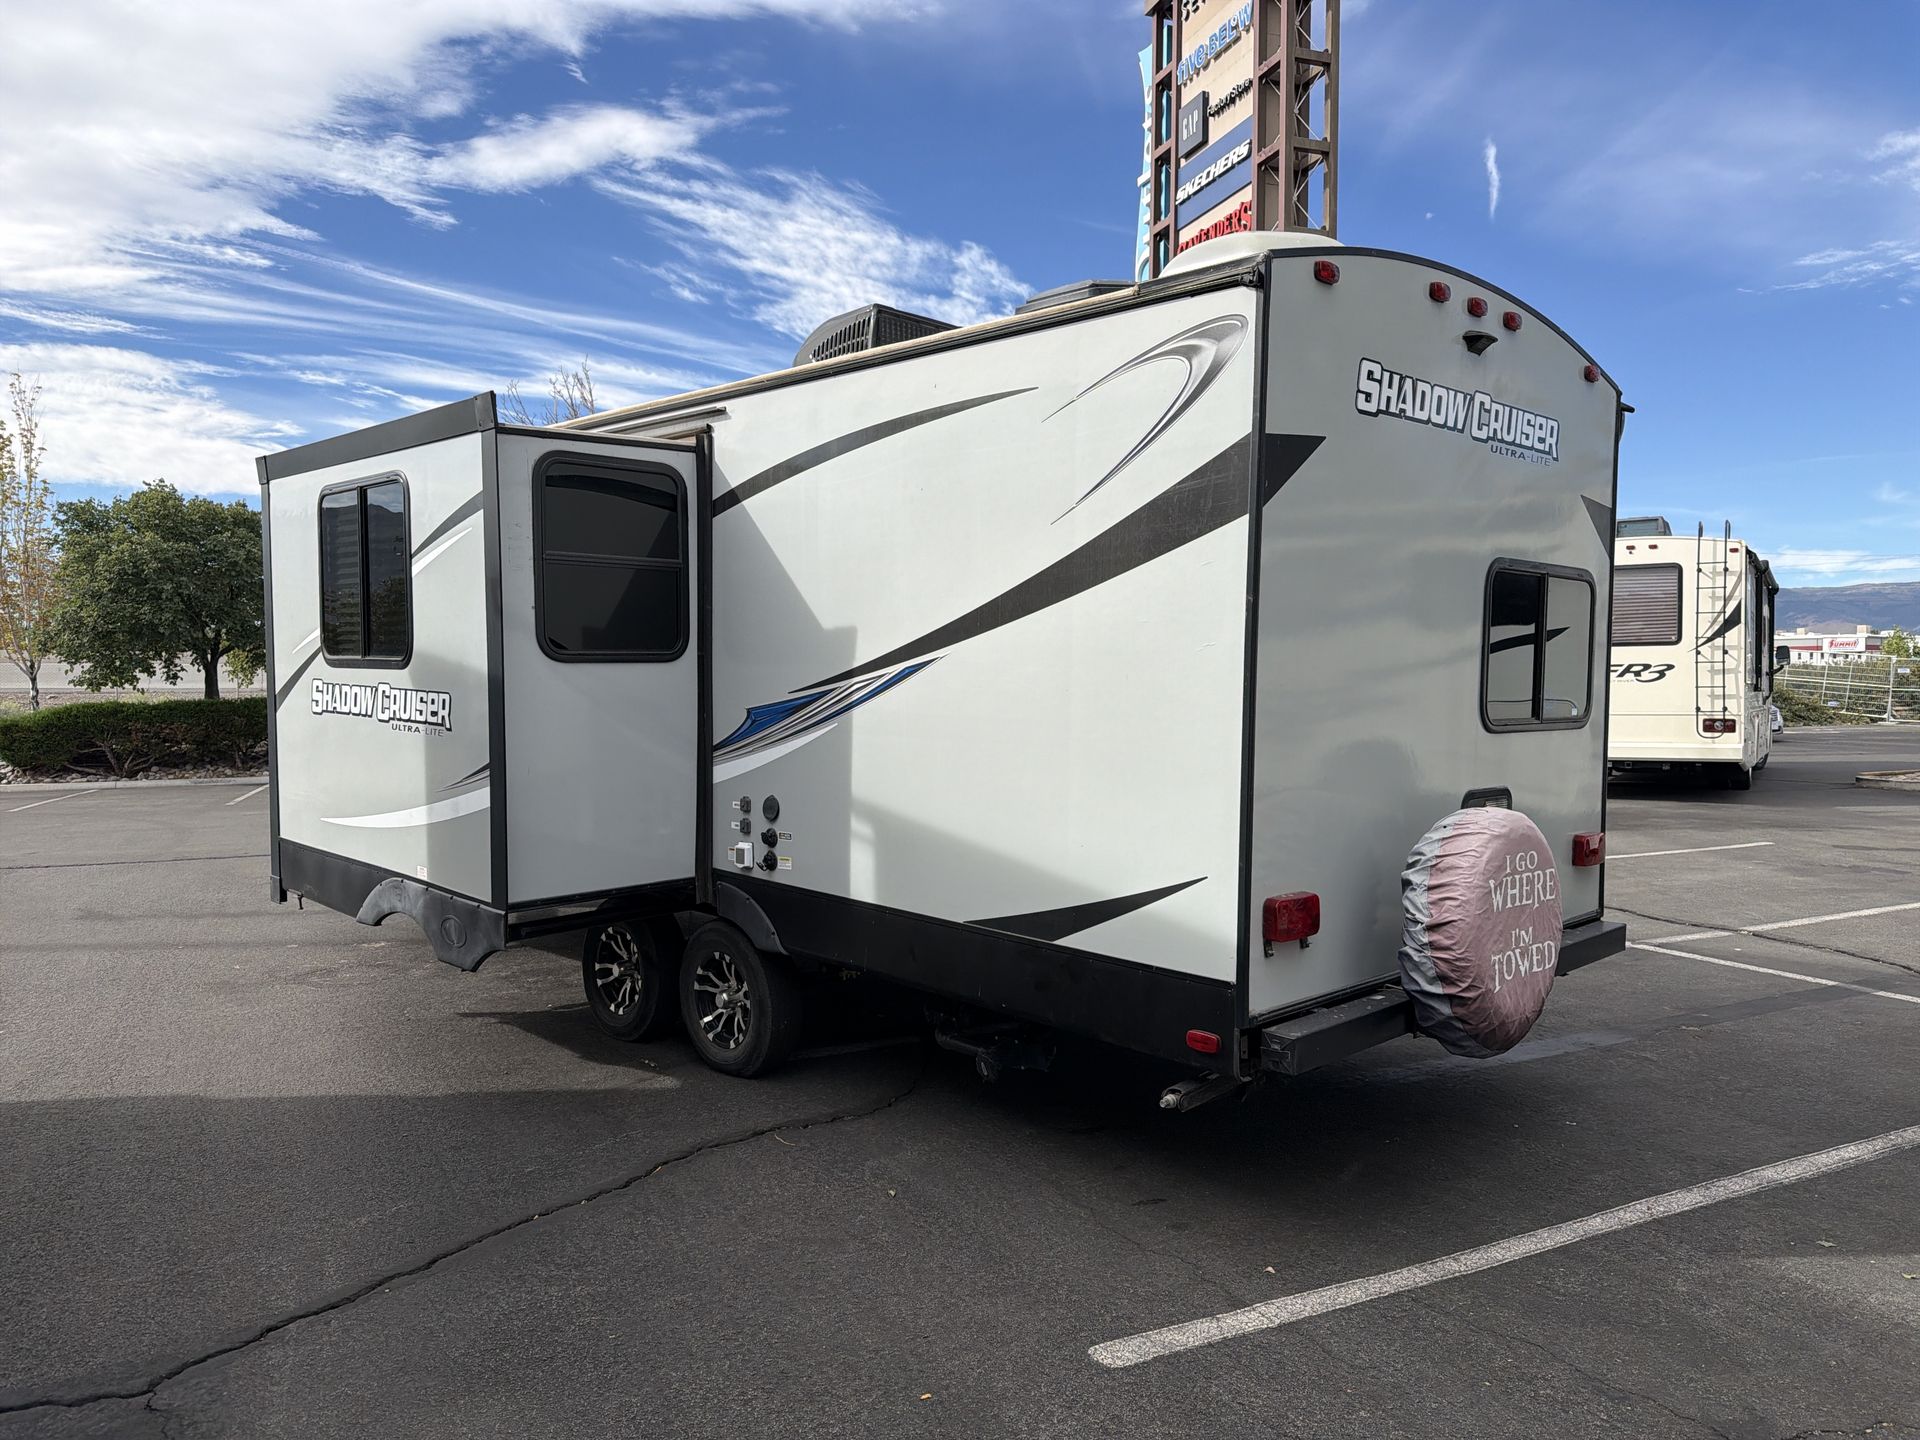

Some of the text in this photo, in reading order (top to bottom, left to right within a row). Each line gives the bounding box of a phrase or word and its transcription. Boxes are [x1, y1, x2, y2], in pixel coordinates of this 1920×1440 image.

[1207, 1, 1254, 57] BELOW
[1176, 139, 1251, 205] SKECHERS
[1490, 444, 1551, 467] ULTRA-LITE
[391, 723, 444, 737] ULTRA-LITE
[1505, 850, 1538, 873] I GO
[1488, 868, 1556, 913] WHERE
[1511, 926, 1534, 948] I'M
[1491, 941, 1556, 994] TOWED
